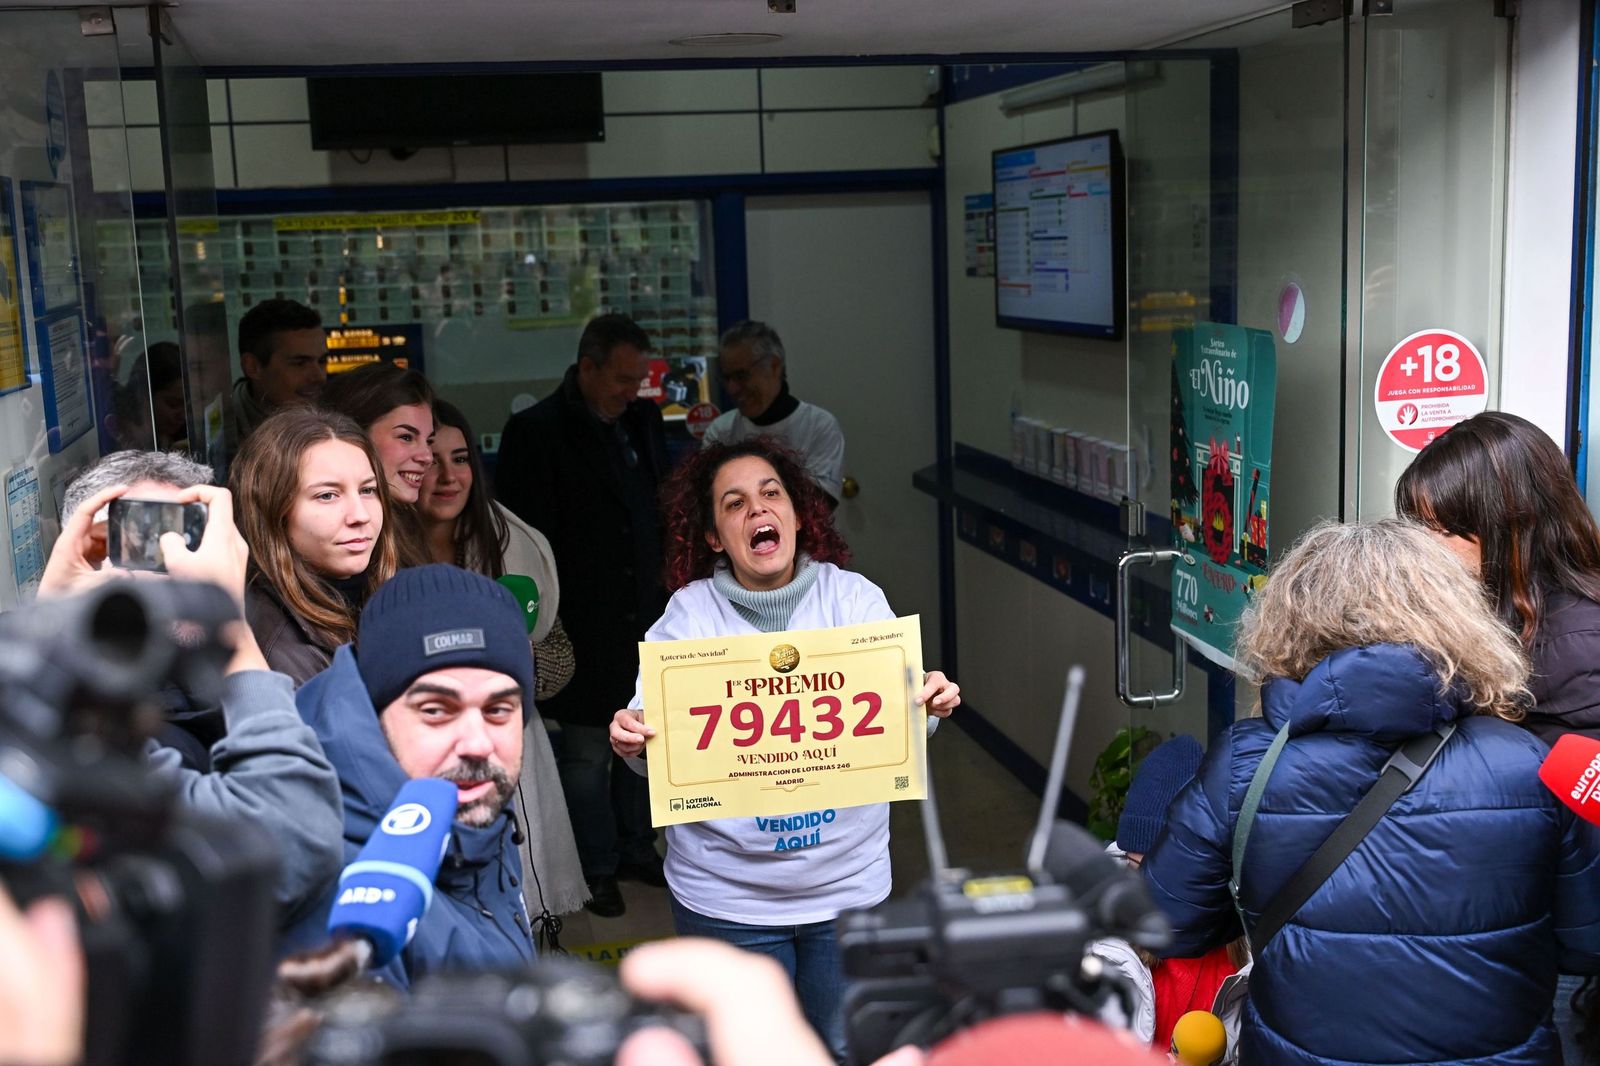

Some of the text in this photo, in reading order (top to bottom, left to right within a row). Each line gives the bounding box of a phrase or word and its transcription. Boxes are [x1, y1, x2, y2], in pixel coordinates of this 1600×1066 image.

[1231, 349, 1237, 358] de
[1400, 343, 1461, 383] +18
[1189, 358, 1250, 411] El Niño
[1387, 389, 1407, 397] JUEGA
[1422, 384, 1476, 394] RESPONSABILIDAD
[1421, 402, 1450, 410] PROHIBIDA
[1176, 568, 1198, 606] 770
[434, 632, 474, 649] COLMAR
[851, 631, 904, 645] 22 de Diciembre
[688, 651, 697, 660] de
[744, 670, 845, 697] PREMIO
[689, 691, 885, 751] 79432
[737, 745, 837, 765] VENDIDO AQUÍ
[728, 762, 851, 778] ADMINISTRACION DE LOTERIAS 246
[776, 777, 805, 787] MADRID
[686, 796, 715, 805] LOTERÍA
[686, 801, 722, 810] NACIONAL
[755, 809, 837, 833] VENDIDO
[773, 829, 821, 853] AQUÍ
[337, 887, 383, 906] ARD
